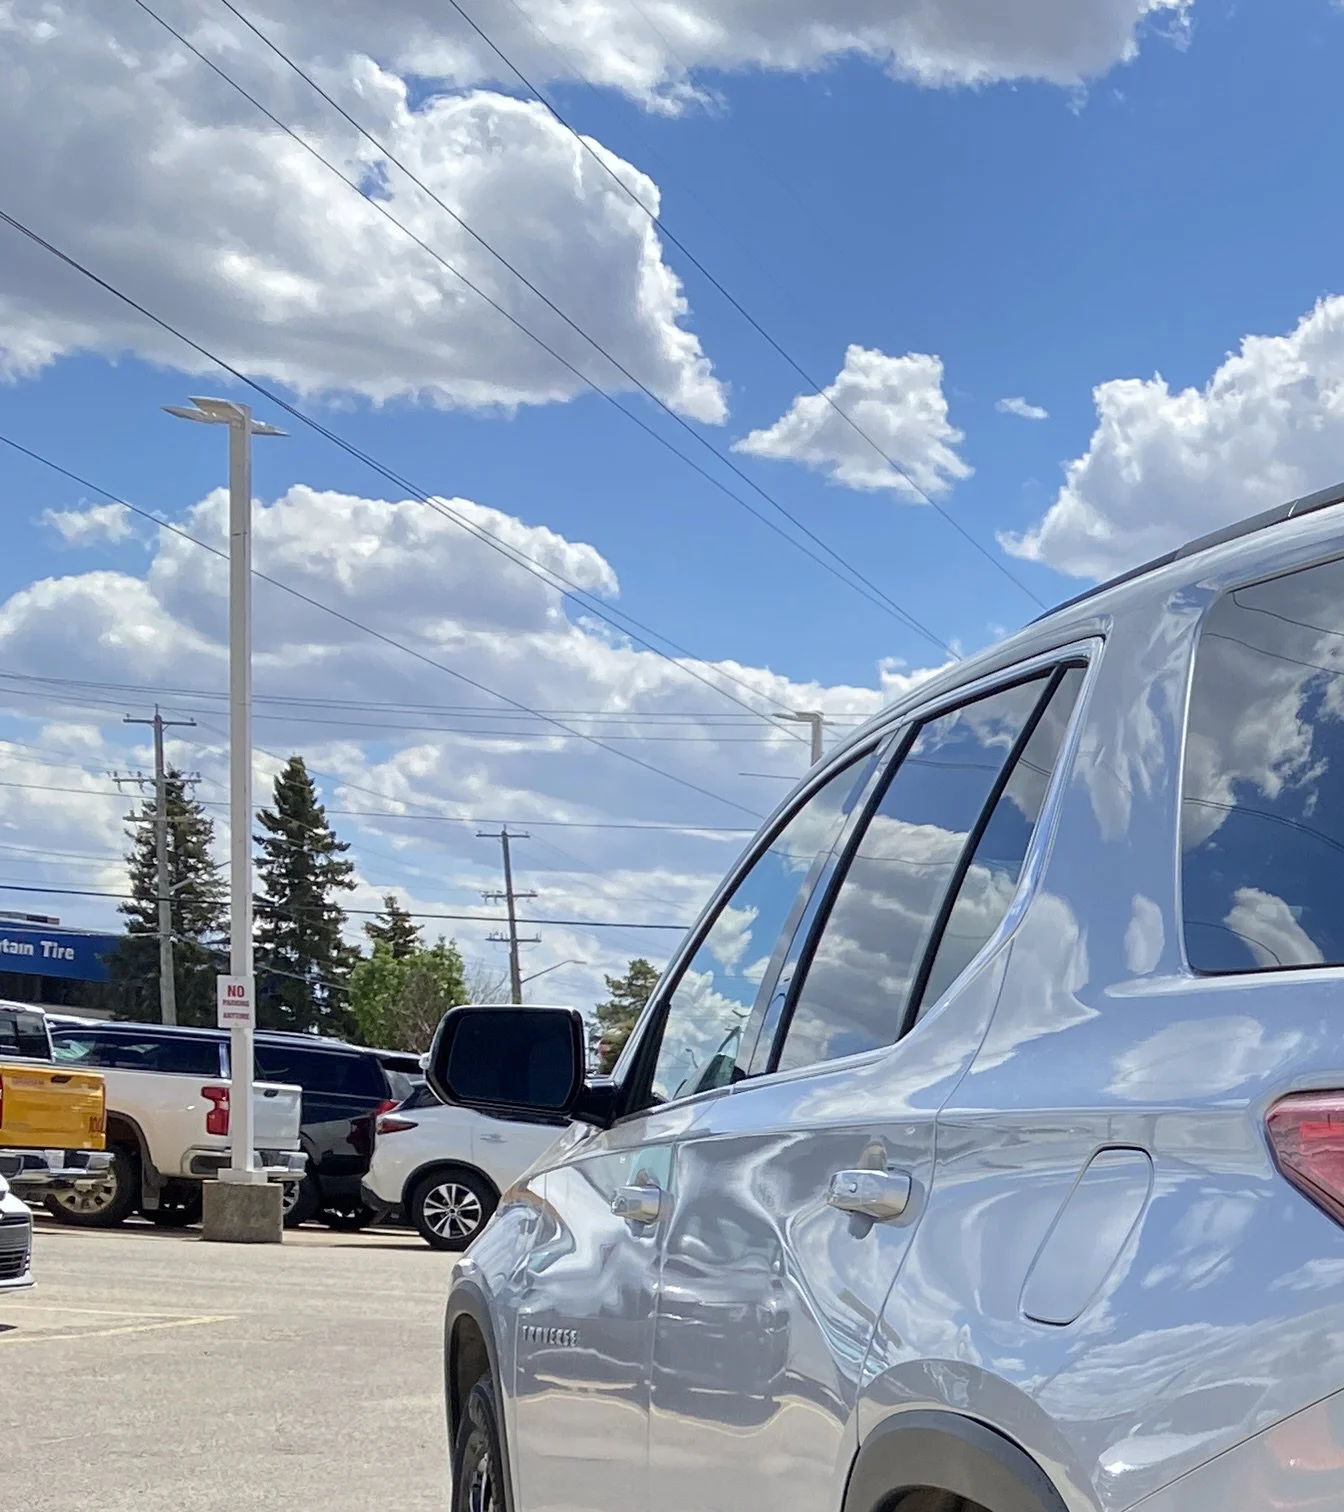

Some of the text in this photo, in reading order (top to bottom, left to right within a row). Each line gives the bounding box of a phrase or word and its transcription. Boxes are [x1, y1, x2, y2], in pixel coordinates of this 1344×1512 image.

[40, 940, 75, 960] Tire
[227, 985, 245, 998] NO
[522, 1325, 577, 1347] TRAVERSE
